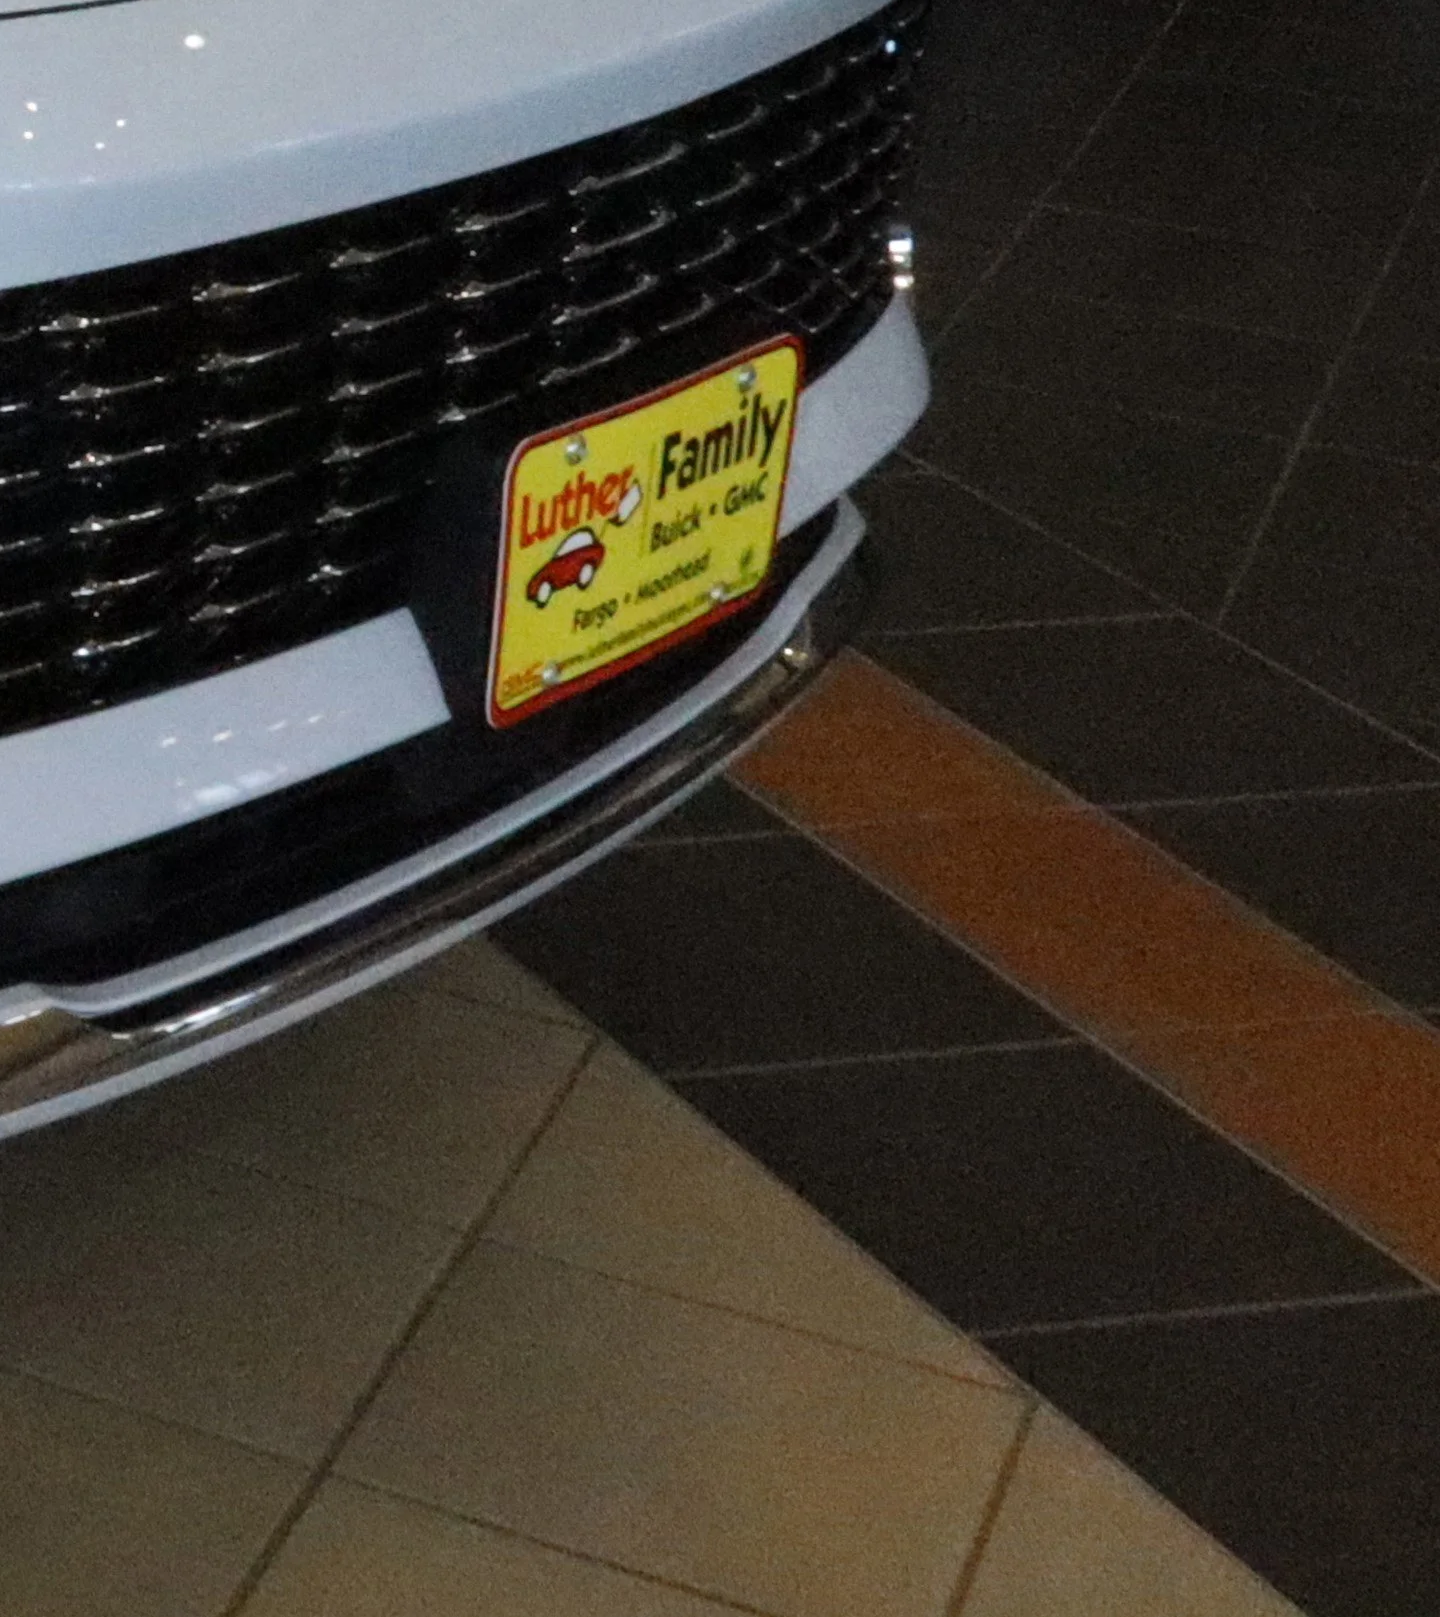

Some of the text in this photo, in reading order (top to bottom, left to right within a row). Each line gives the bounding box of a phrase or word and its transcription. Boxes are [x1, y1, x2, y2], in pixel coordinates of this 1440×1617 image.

[657, 393, 787, 501] Family
[519, 465, 634, 549] Luther
[649, 471, 769, 553] Buick GMC
[572, 597, 619, 634] Fargo
